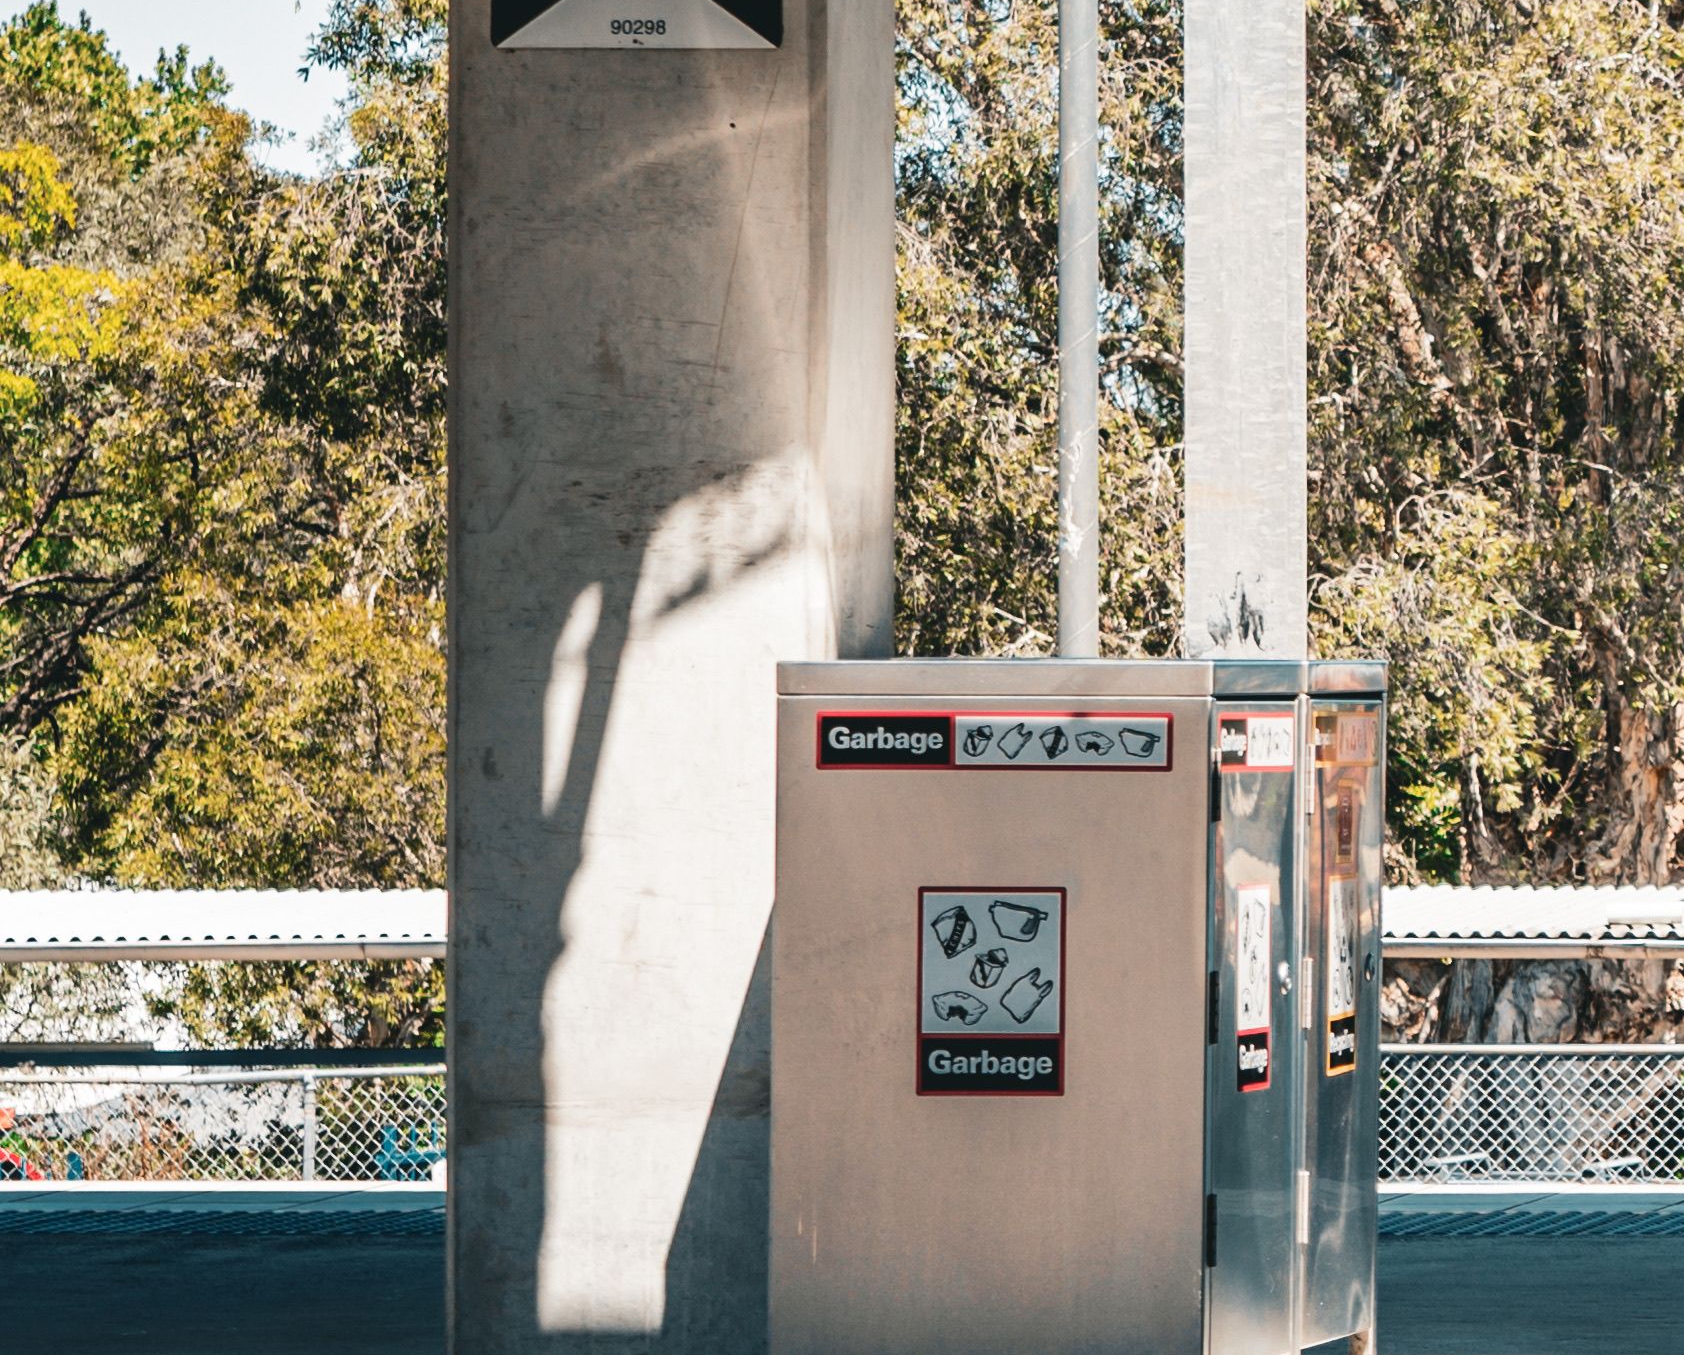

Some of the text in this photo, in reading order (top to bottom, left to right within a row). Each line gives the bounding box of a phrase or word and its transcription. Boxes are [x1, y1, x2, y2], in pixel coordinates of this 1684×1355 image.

[610, 19, 667, 35] 90298
[828, 726, 944, 754] Garbage
[928, 1049, 1053, 1080] Garbage
